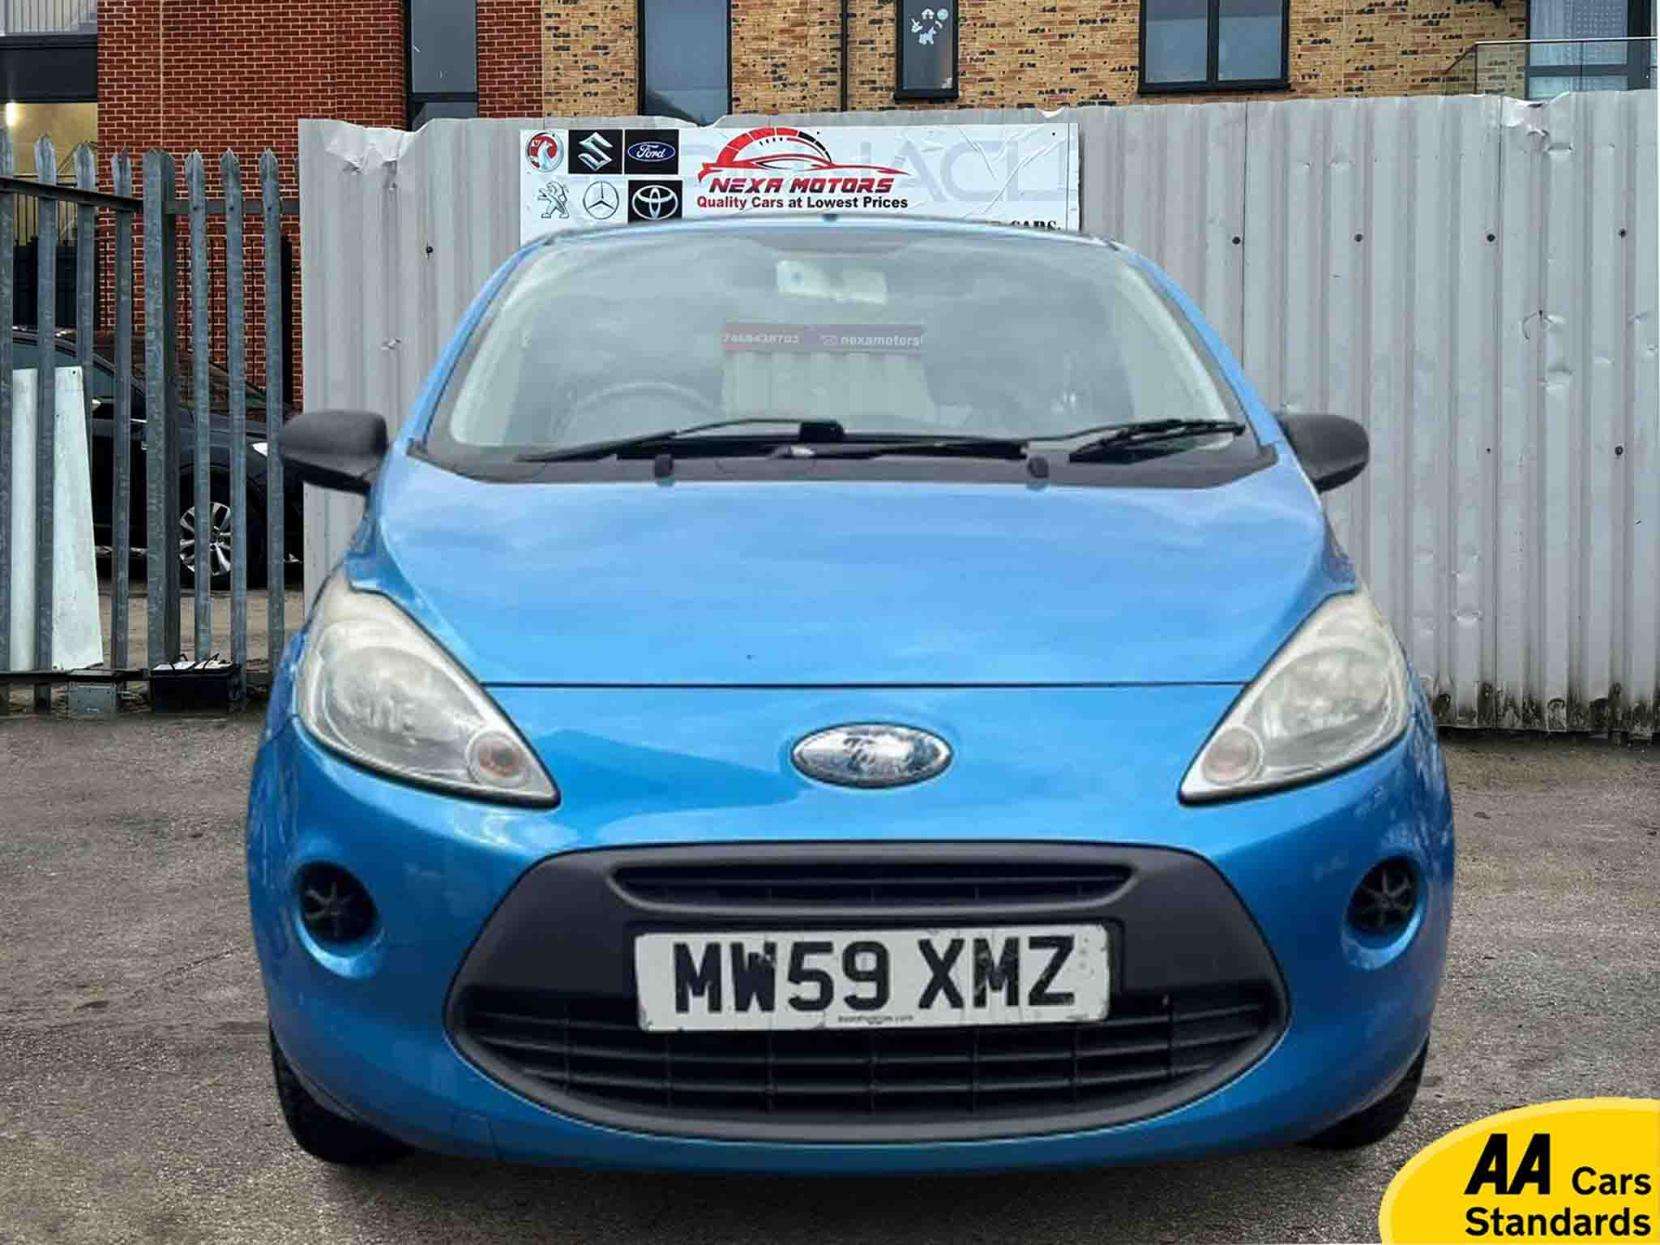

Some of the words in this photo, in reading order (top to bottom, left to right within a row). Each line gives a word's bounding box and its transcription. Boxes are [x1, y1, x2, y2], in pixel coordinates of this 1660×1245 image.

[636, 144, 666, 159] Ford
[708, 177, 783, 194] NEXA
[789, 177, 894, 194] MOTORS
[697, 196, 747, 210] Quality
[752, 196, 784, 208] Cars
[788, 196, 803, 208] at
[807, 196, 859, 208] Lowest
[863, 195, 908, 208] Prices
[673, 940, 889, 1014] MW59
[917, 935, 1076, 1010] XMZ
